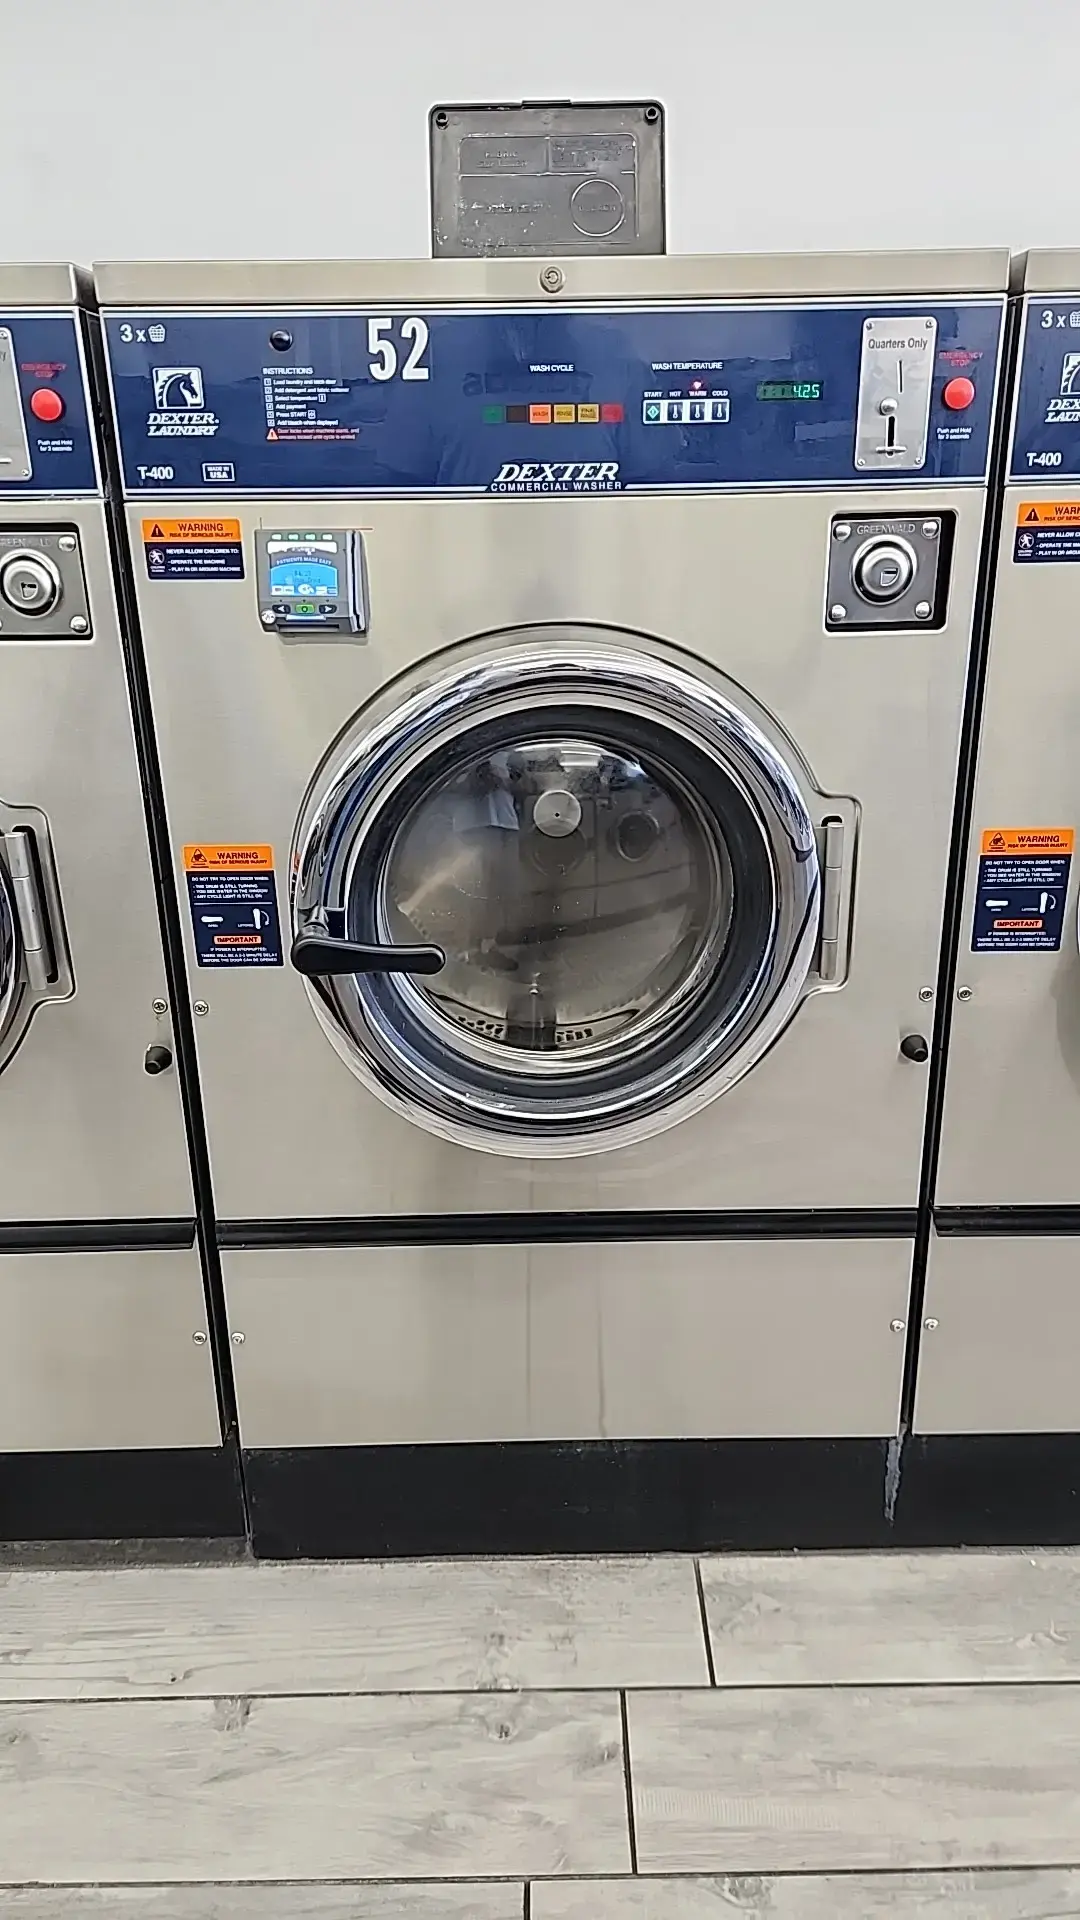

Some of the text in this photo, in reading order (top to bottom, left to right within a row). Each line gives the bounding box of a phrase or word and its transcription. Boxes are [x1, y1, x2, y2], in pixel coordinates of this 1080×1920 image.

[1041, 310, 1054, 328] 3
[120, 324, 133, 342] 3
[368, 317, 429, 380] 52
[868, 337, 928, 350] Quarters Only
[262, 367, 313, 375] INSTRUCTIONS
[673, 362, 723, 370] TEMPERATURE
[147, 426, 218, 436] LAUNDRY
[1026, 452, 1062, 466] T-400
[137, 466, 174, 480] T-400
[494, 463, 619, 482] DEXTER
[490, 482, 622, 492] COMMERCIAL WASHER
[178, 523, 224, 531] WARNING
[217, 852, 259, 860] WARNING
